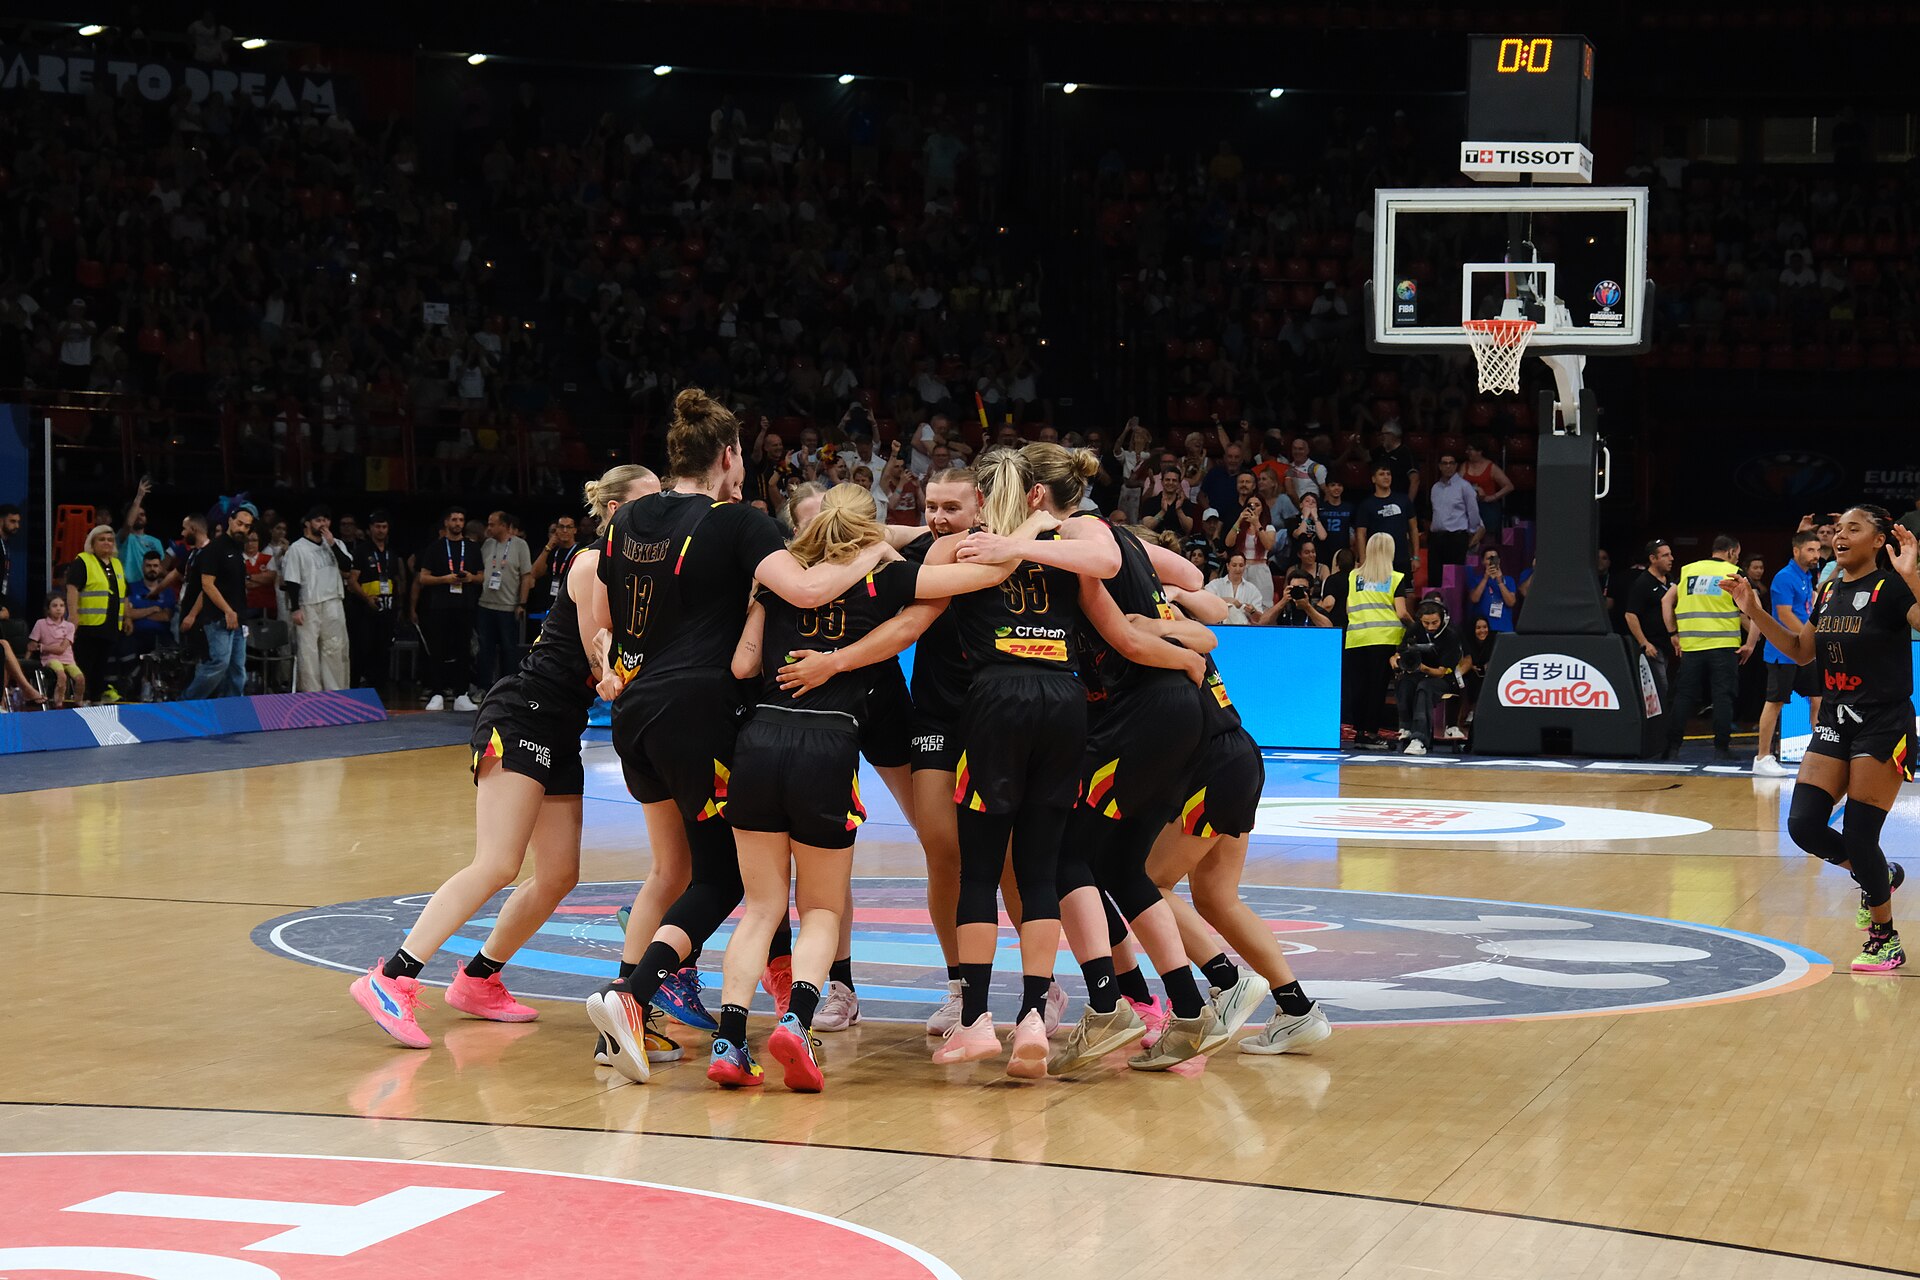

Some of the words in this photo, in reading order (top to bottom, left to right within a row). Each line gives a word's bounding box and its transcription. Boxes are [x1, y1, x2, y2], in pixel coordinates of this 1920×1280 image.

[0, 52, 97, 95] ARE
[107, 60, 172, 102] TO
[185, 67, 337, 114] DREAM
[1496, 150, 1574, 165] TISSOT
[1398, 304, 1414, 313] FIBA
[1327, 518, 1342, 532] 12
[625, 573, 654, 639] 13
[1009, 644, 1058, 657] DHL
[1827, 641, 1844, 664] 31
[1520, 662, 1586, 681] 百岁山
[1820, 733, 1841, 743] ADE
[518, 739, 551, 759] POWE
[920, 743, 944, 752] ADE
